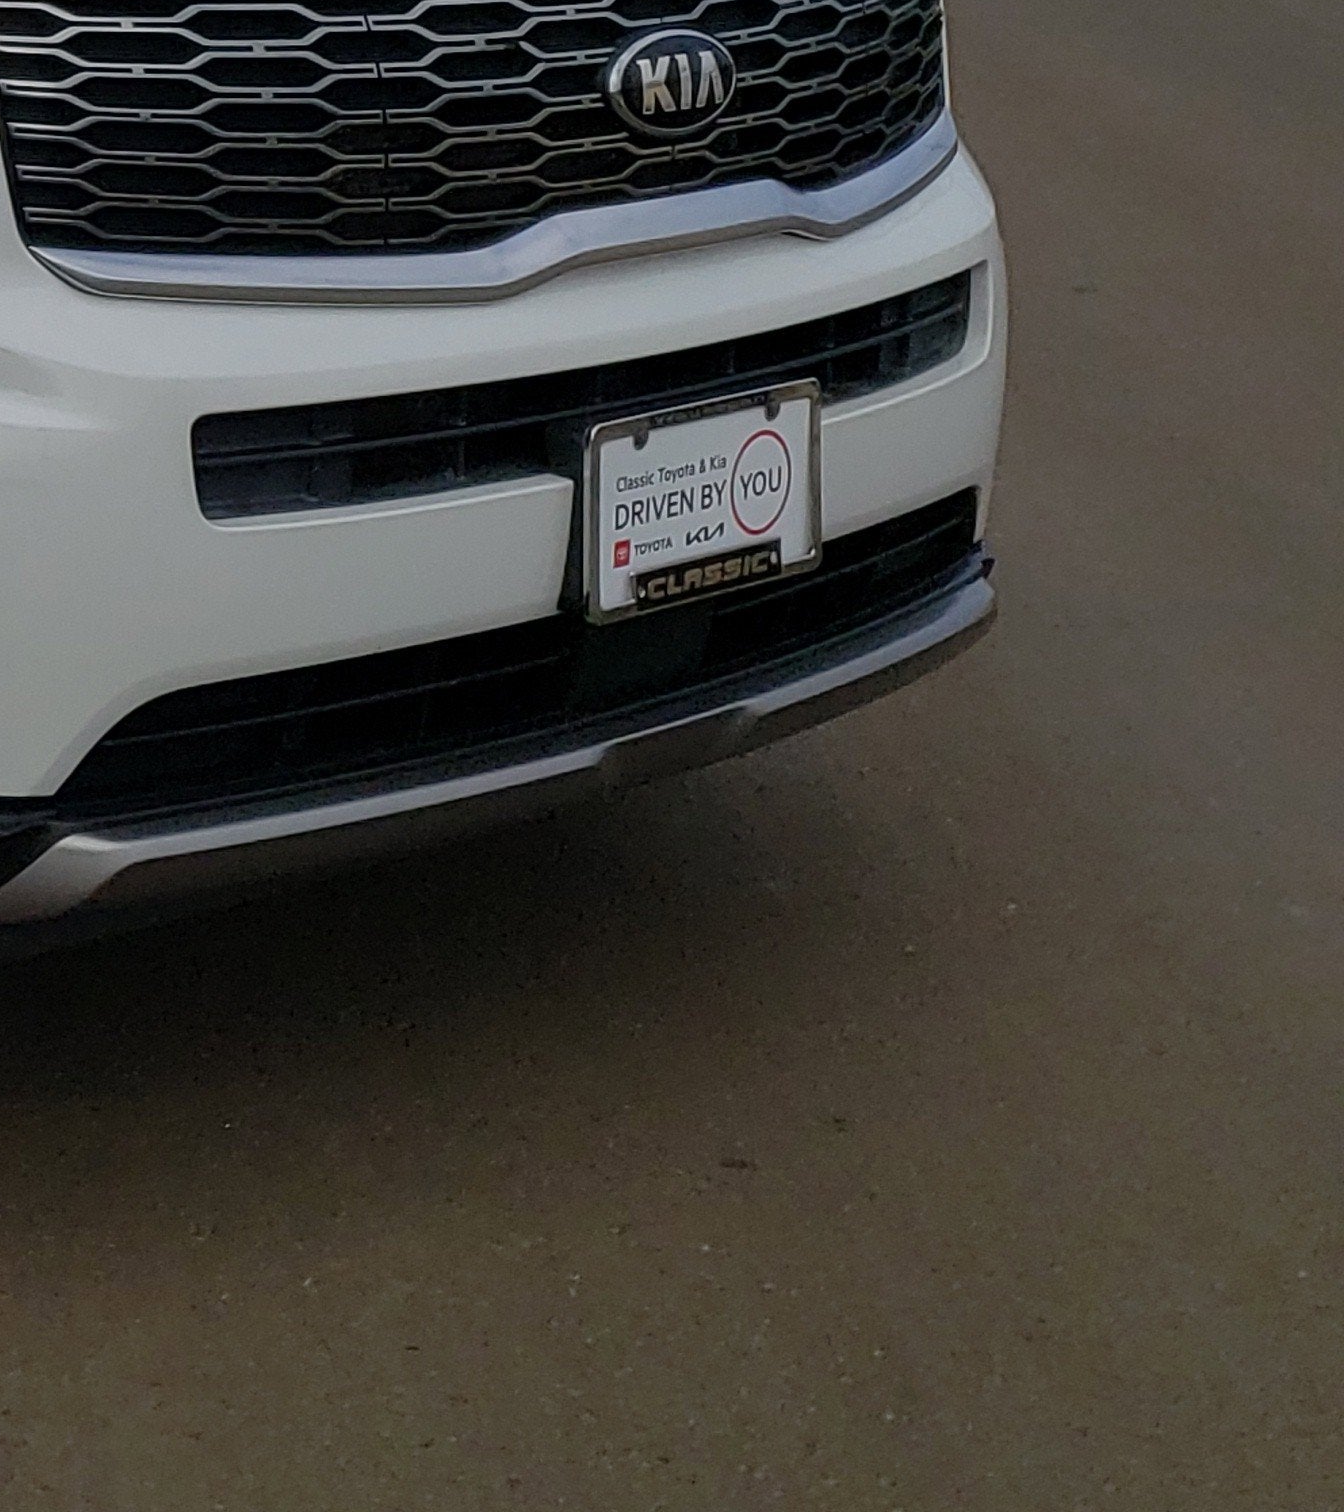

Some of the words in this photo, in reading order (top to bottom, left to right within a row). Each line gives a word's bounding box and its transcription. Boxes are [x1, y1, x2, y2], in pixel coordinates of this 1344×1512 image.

[636, 50, 723, 114] KIA
[614, 487, 694, 530] DRIVEN
[701, 479, 727, 510] BY
[740, 466, 782, 500] YOU
[616, 472, 654, 492] Classic
[657, 464, 695, 483] Toyota
[699, 458, 706, 474] &
[710, 455, 727, 470] Kia
[634, 537, 673, 556] TOYOTA
[685, 522, 725, 546] KIA
[647, 551, 770, 600] CLASSIC
